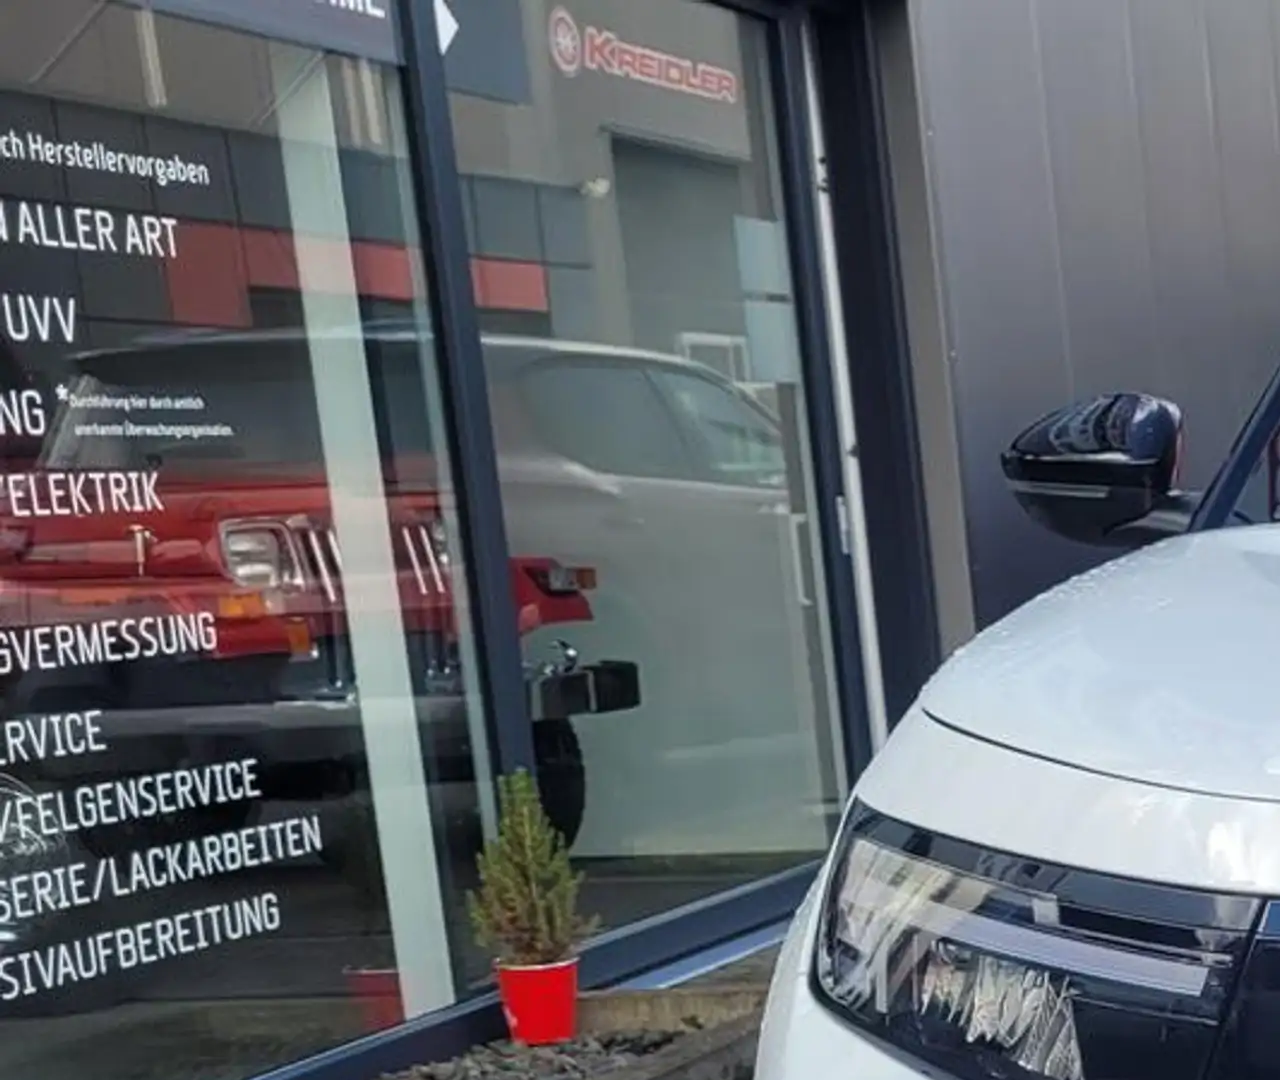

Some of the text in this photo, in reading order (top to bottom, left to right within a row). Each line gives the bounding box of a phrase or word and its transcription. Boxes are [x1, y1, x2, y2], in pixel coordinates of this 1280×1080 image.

[584, 25, 738, 104] KREIDLER
[27, 132, 210, 186] Herstellervorgaben
[18, 201, 117, 252] ALLER
[126, 213, 178, 259] ART
[2, 294, 76, 343] UVV
[0, 892, 281, 1000] SIVAUFBEREITUNG
